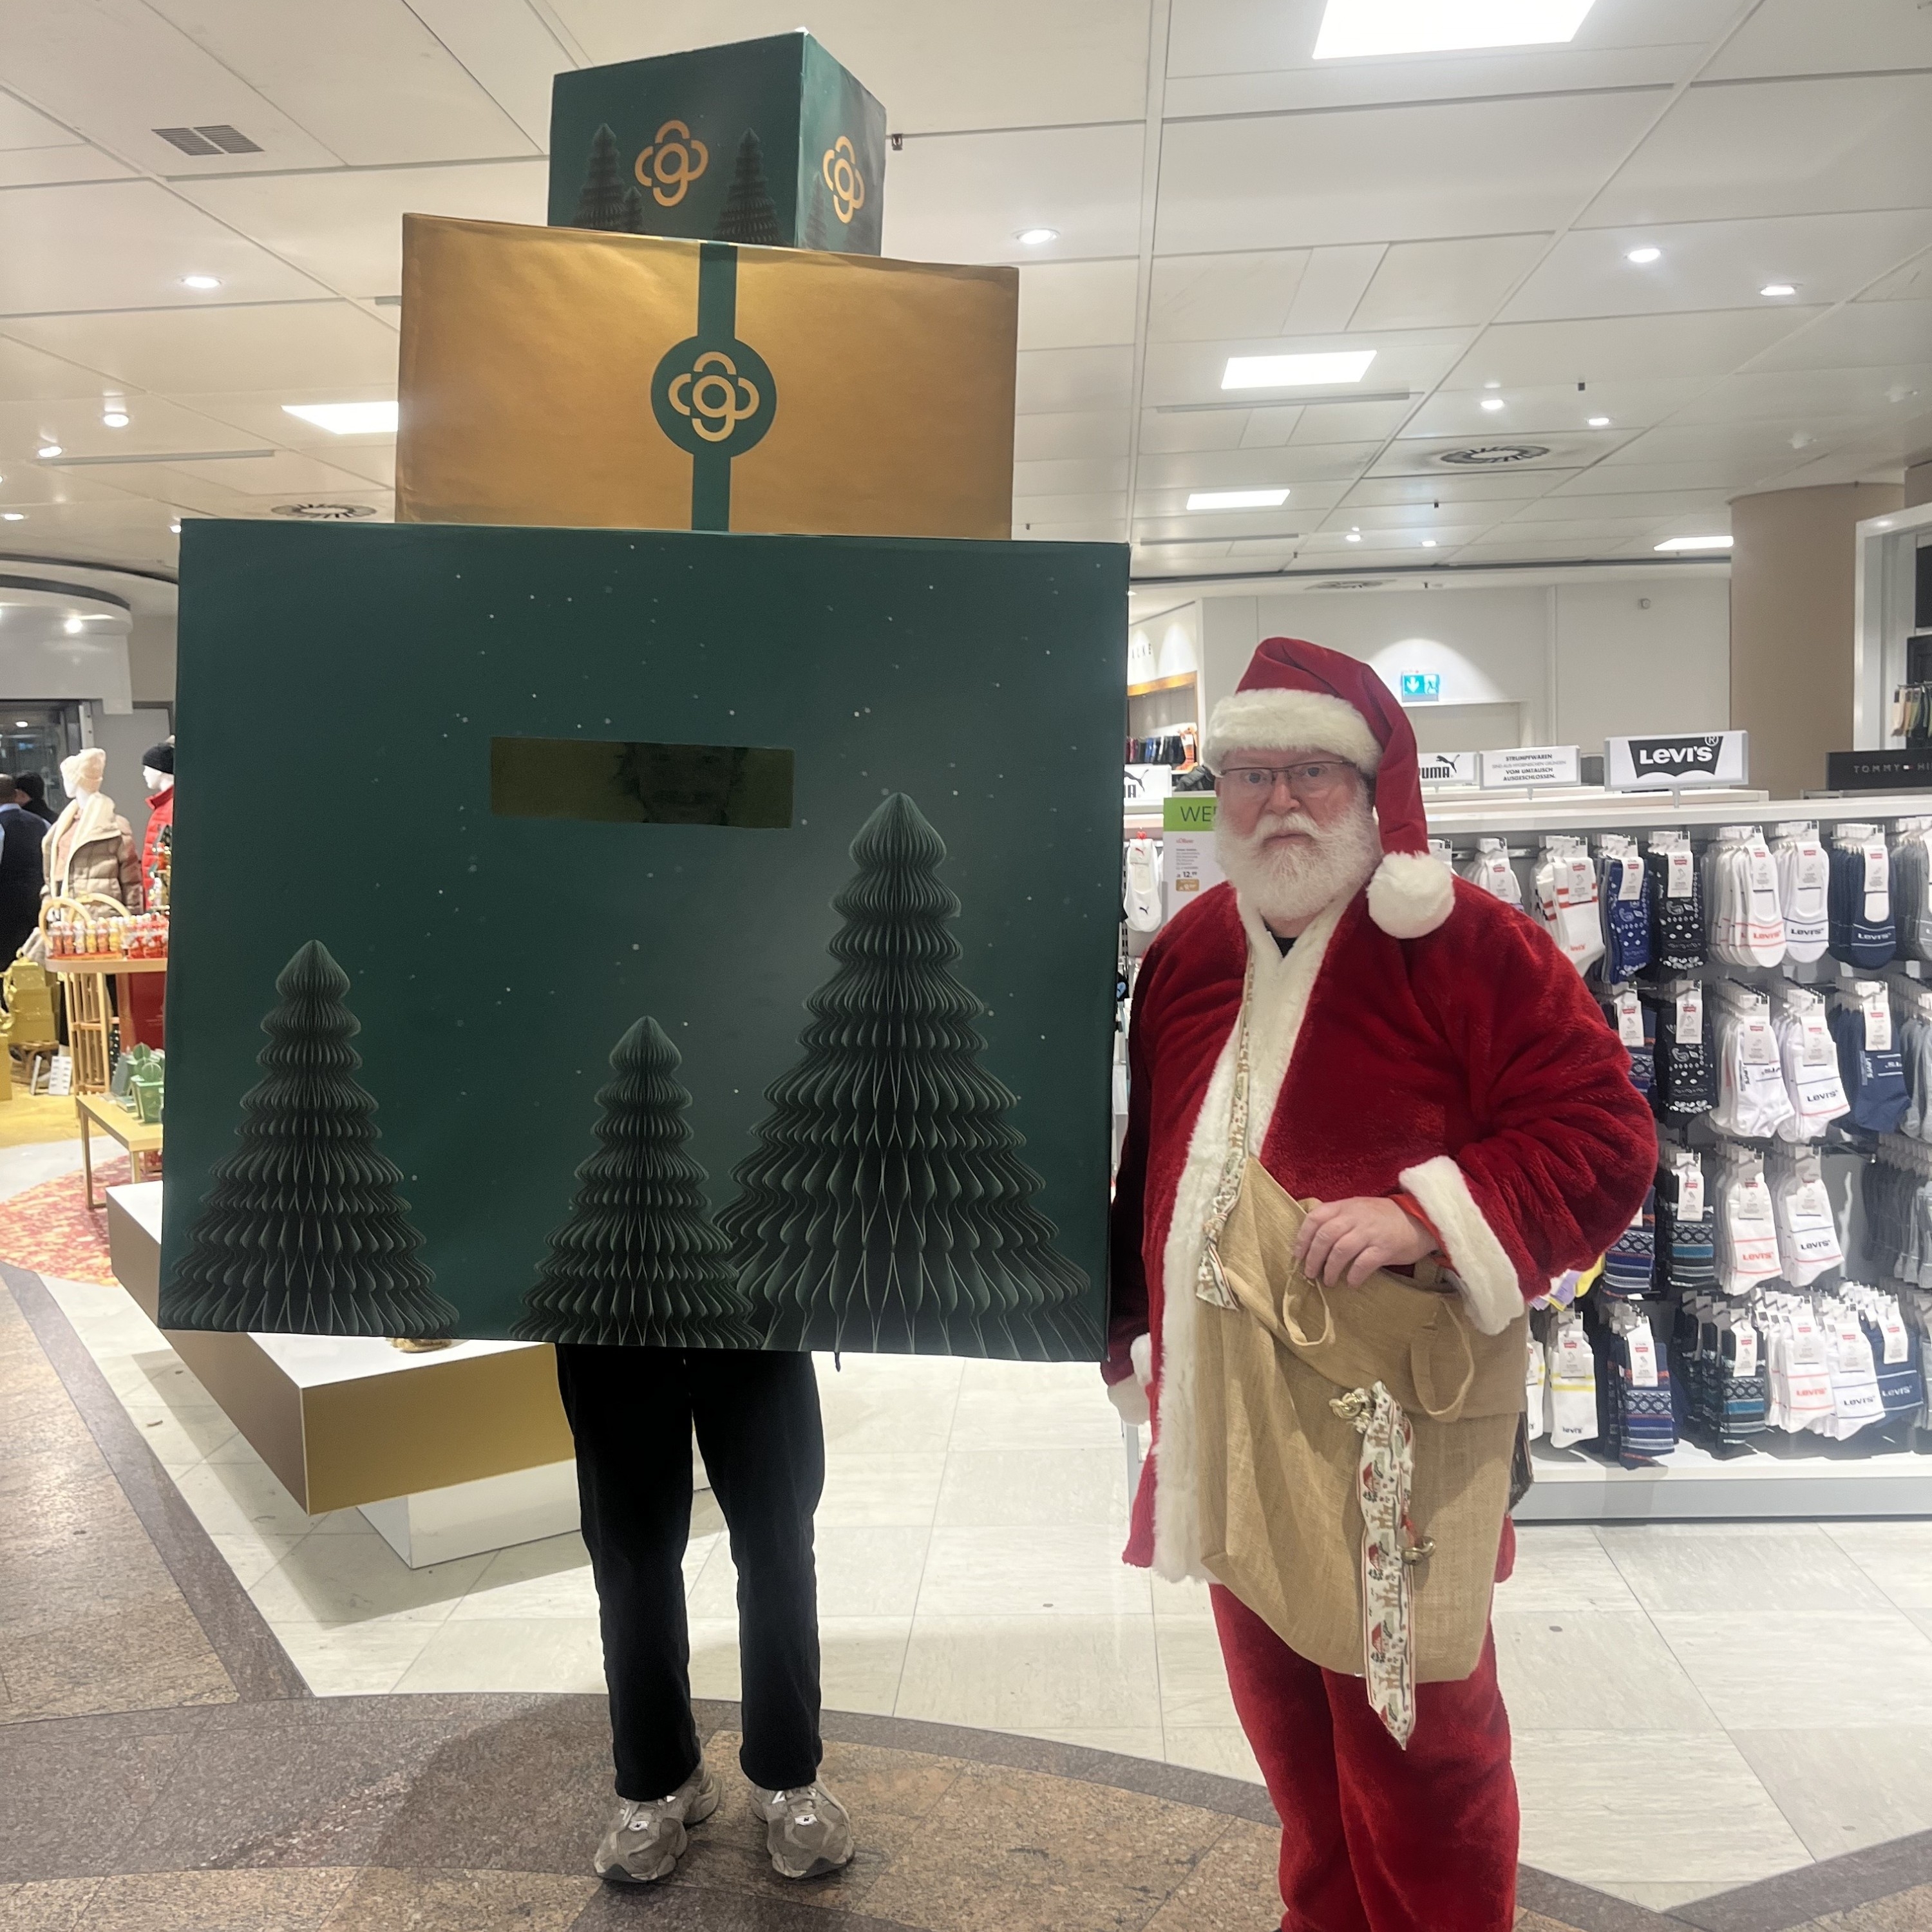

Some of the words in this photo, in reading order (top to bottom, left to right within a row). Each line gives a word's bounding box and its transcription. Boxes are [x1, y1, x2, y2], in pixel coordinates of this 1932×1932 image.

[1853, 764, 1900, 773] TOMMY
[1917, 762, 1932, 772] HI
[1180, 806, 1217, 822] WE
